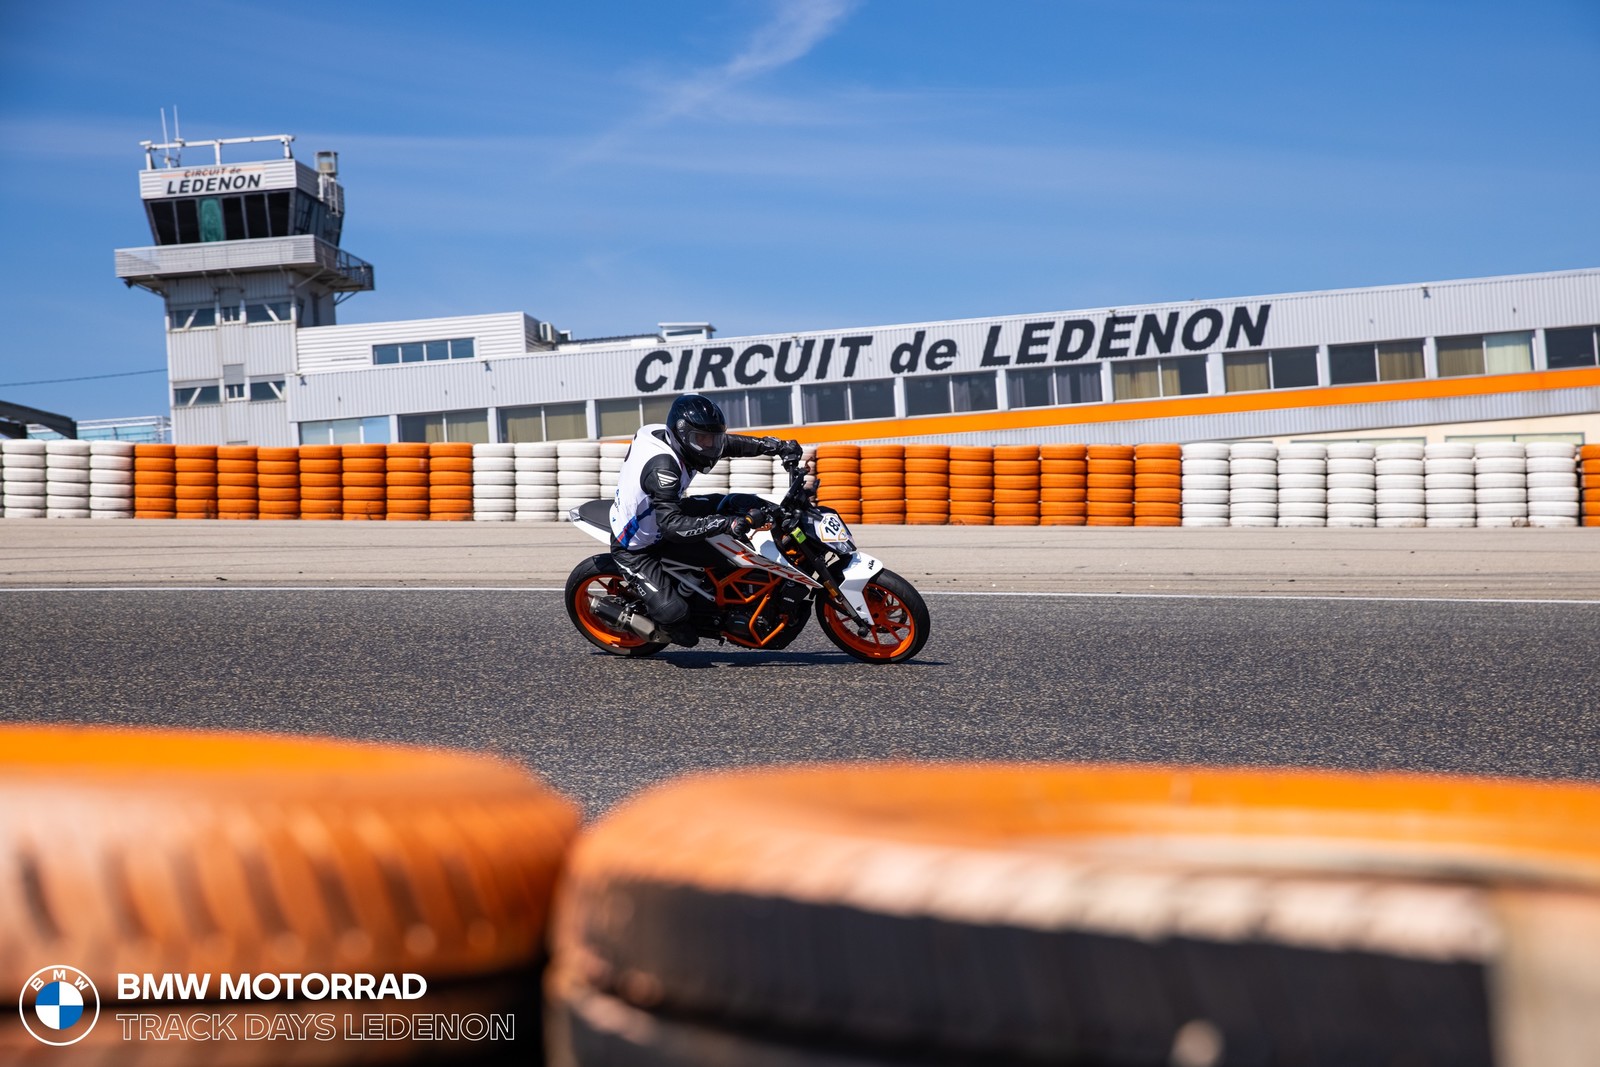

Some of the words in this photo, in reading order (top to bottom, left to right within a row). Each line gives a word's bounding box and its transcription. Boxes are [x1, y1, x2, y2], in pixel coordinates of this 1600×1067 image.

[184, 168, 226, 178] CIRCUIT
[167, 174, 261, 195] LEDENON
[634, 335, 873, 392] CIRCUIT
[889, 331, 957, 374] de
[979, 304, 1271, 367] LEDENON
[824, 516, 841, 536] 183
